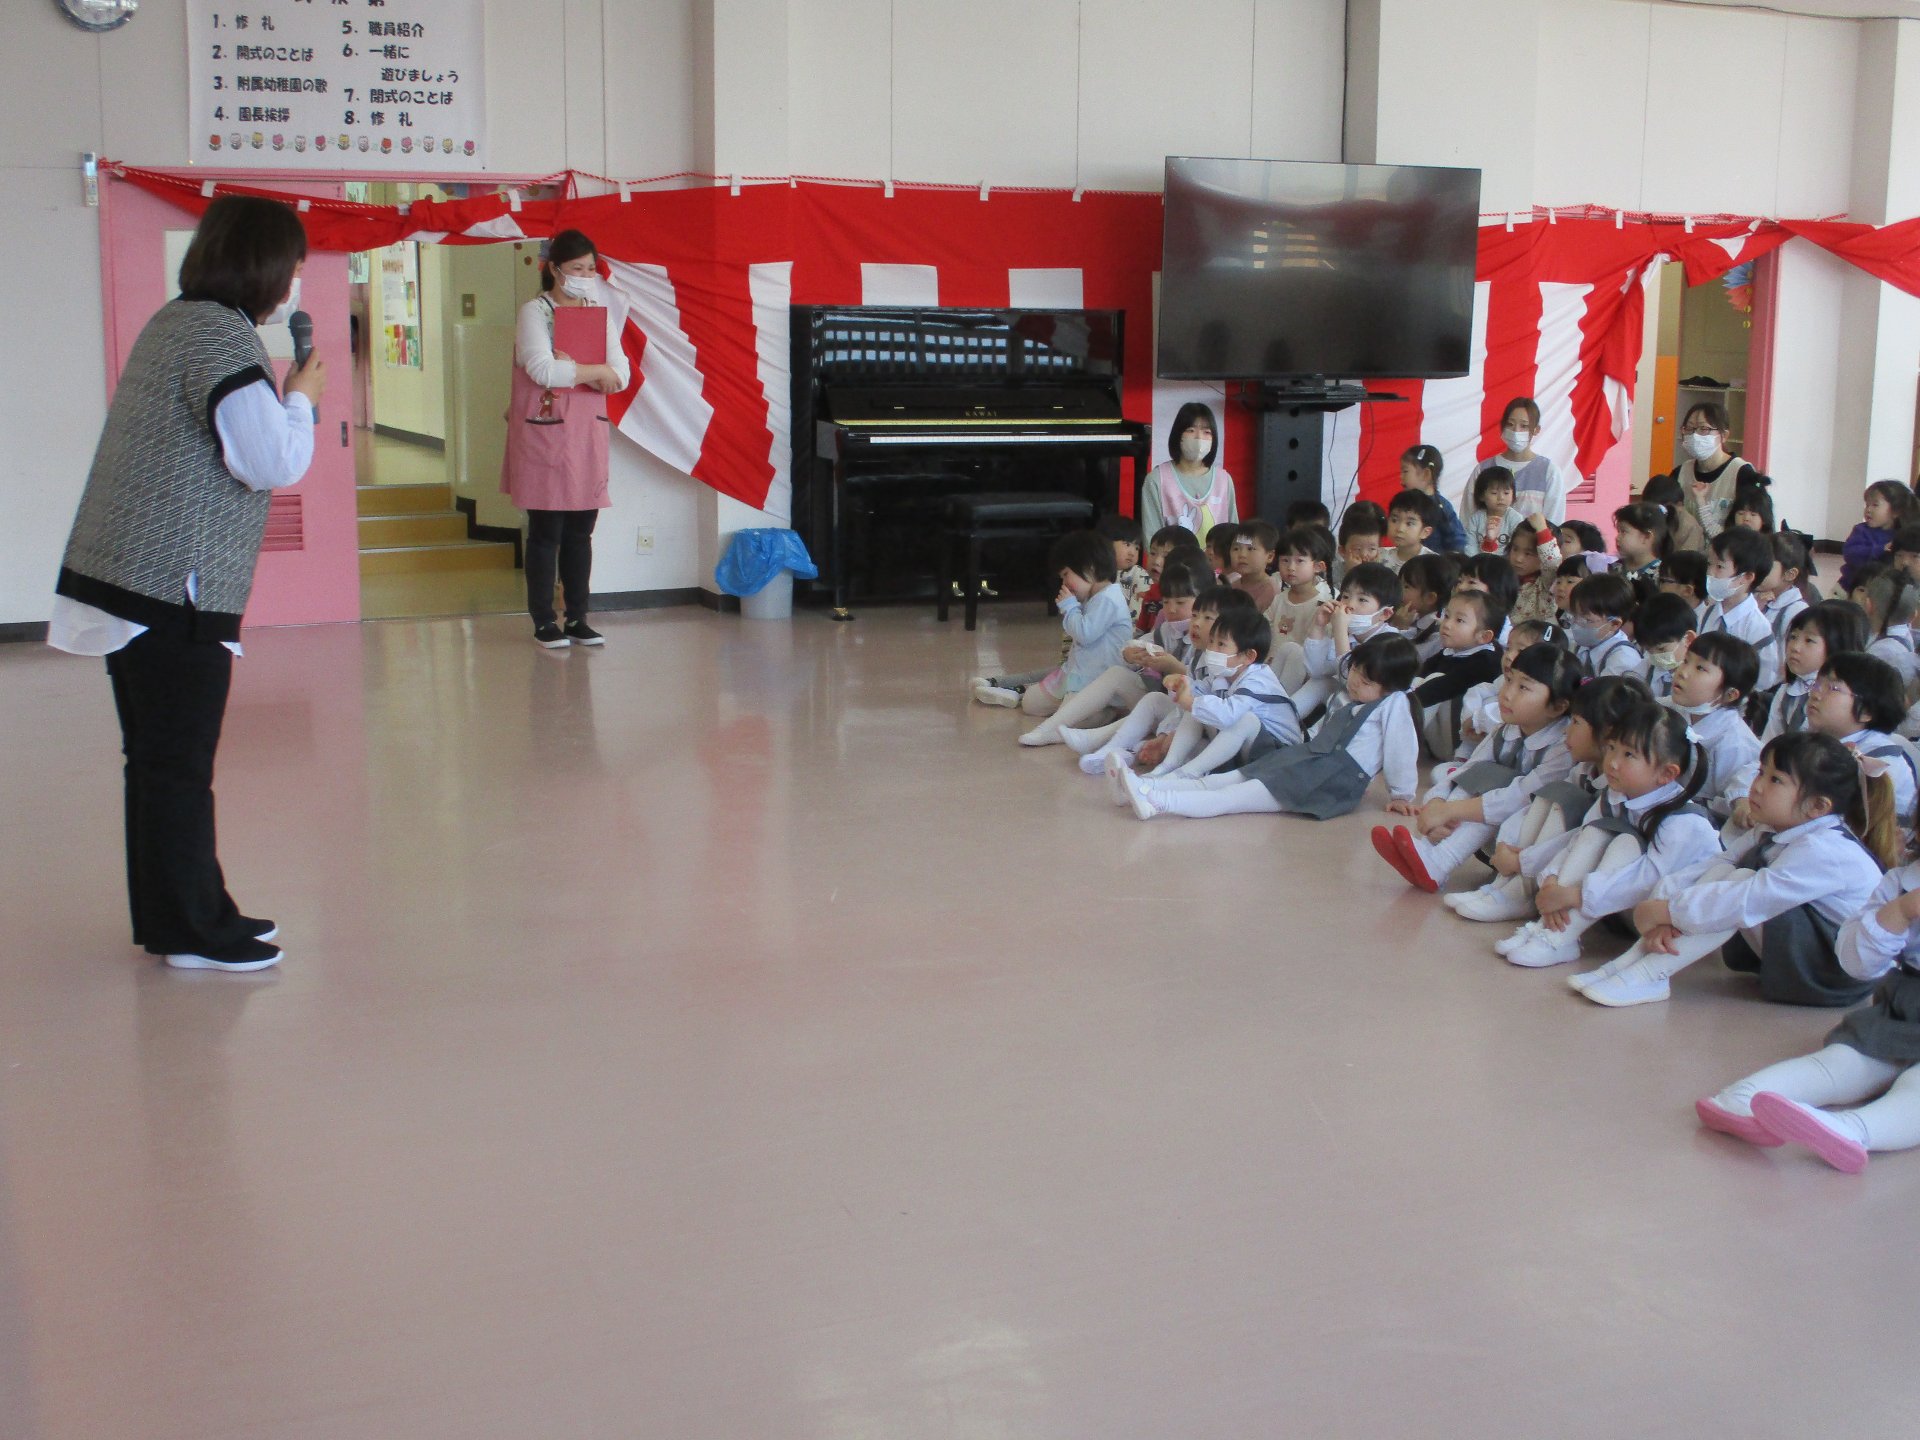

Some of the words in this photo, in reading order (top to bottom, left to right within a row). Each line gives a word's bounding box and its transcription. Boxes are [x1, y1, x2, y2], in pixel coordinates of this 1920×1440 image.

[342, 20, 358, 34] 5.
[368, 21, 424, 38] 職員紹介
[212, 45, 227, 60] 2.
[236, 46, 314, 62] 開式のことば
[342, 43, 358, 57] 6.
[369, 44, 410, 59] 一緒に
[381, 67, 459, 84] 遊びましょう
[213, 76, 228, 90] 3.
[237, 76, 328, 93] 附属幼稚園の歌
[344, 88, 360, 102] 7.
[370, 89, 454, 105] 閉式のことば
[214, 107, 229, 121] 4.
[238, 106, 290, 123] 園長挨拶
[344, 111, 360, 125] 8.
